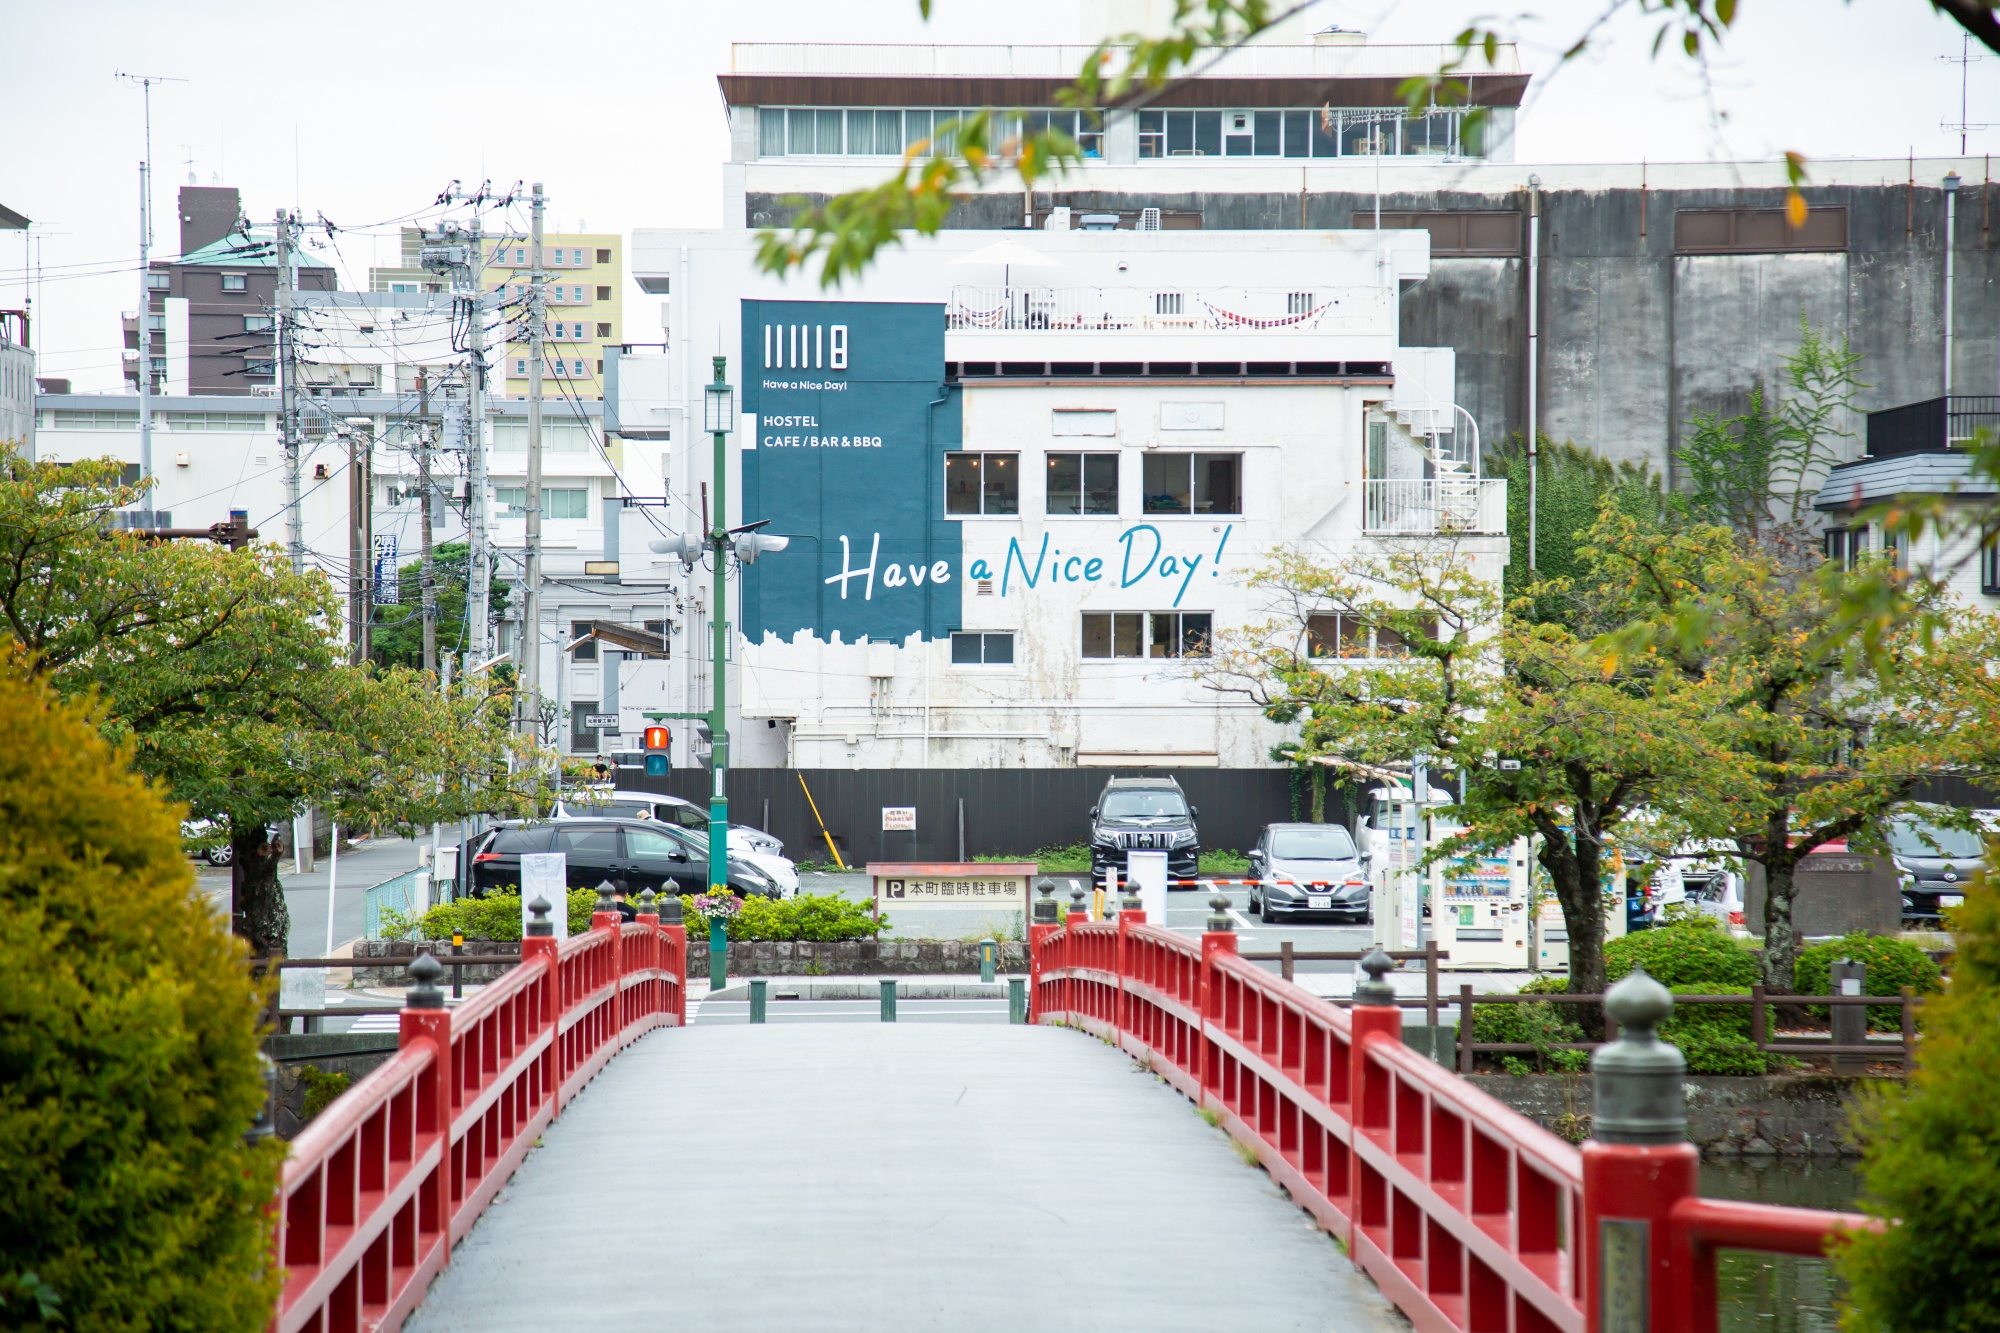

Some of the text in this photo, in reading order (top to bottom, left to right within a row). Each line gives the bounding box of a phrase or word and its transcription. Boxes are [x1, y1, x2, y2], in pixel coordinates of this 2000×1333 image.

[763, 379, 848, 392] Have a Nice Day!
[763, 415, 819, 427] HOSTEL
[853, 436, 882, 448] BBQ
[824, 524, 1233, 608] Have a Nice Day!
[890, 881, 1017, 897] P 本町臨時駐車場
